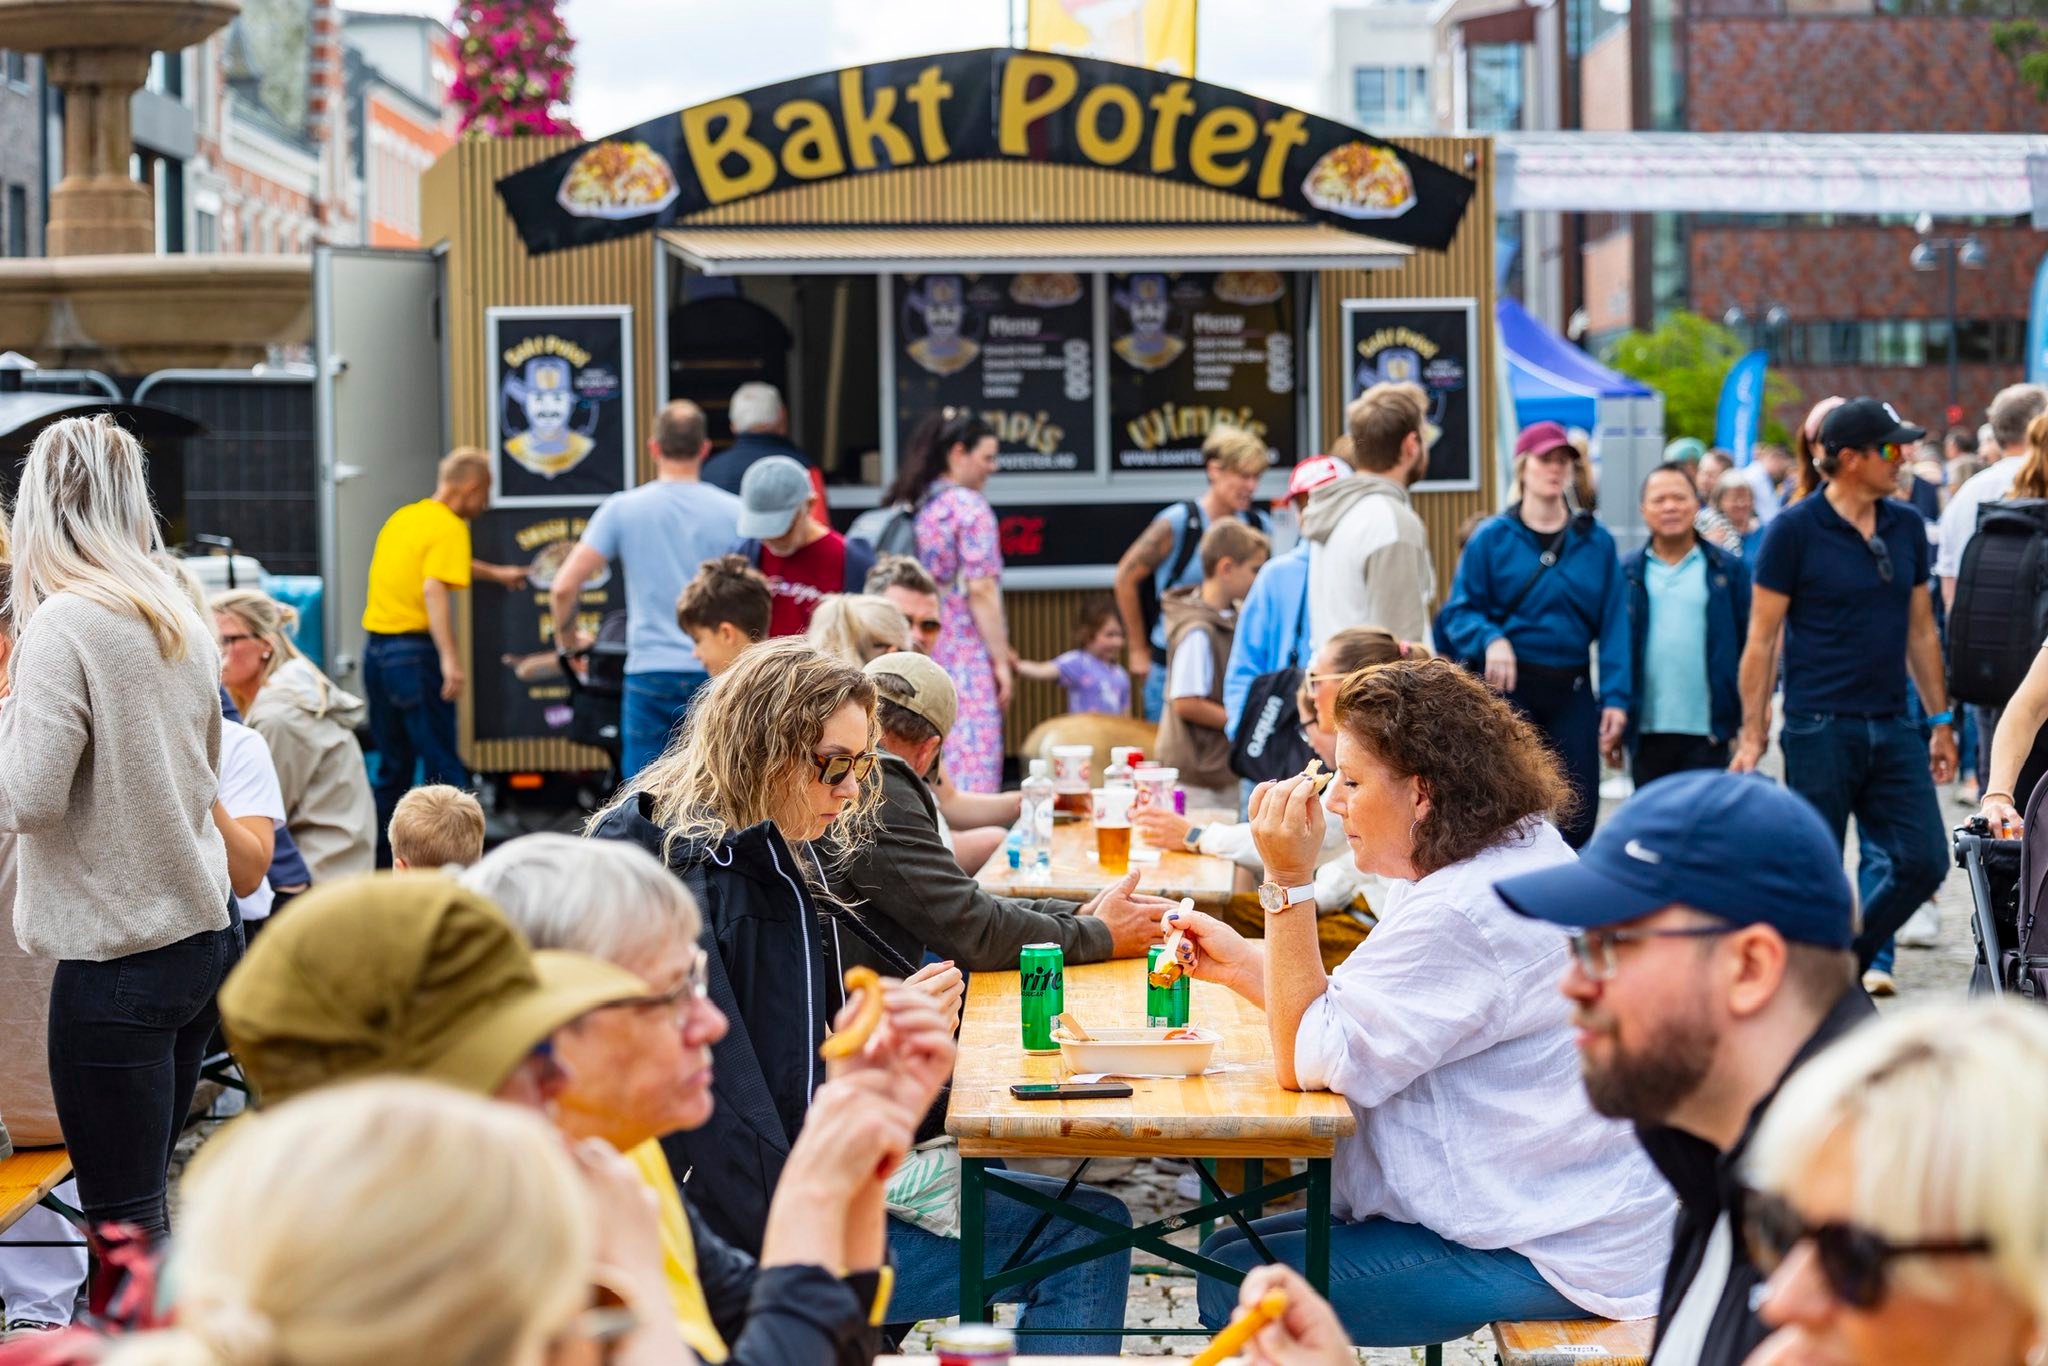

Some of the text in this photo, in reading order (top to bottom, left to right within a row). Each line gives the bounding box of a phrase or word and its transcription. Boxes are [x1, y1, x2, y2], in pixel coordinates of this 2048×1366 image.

[681, 54, 1311, 205] Bakt Potet
[1020, 966, 1063, 991] rite
